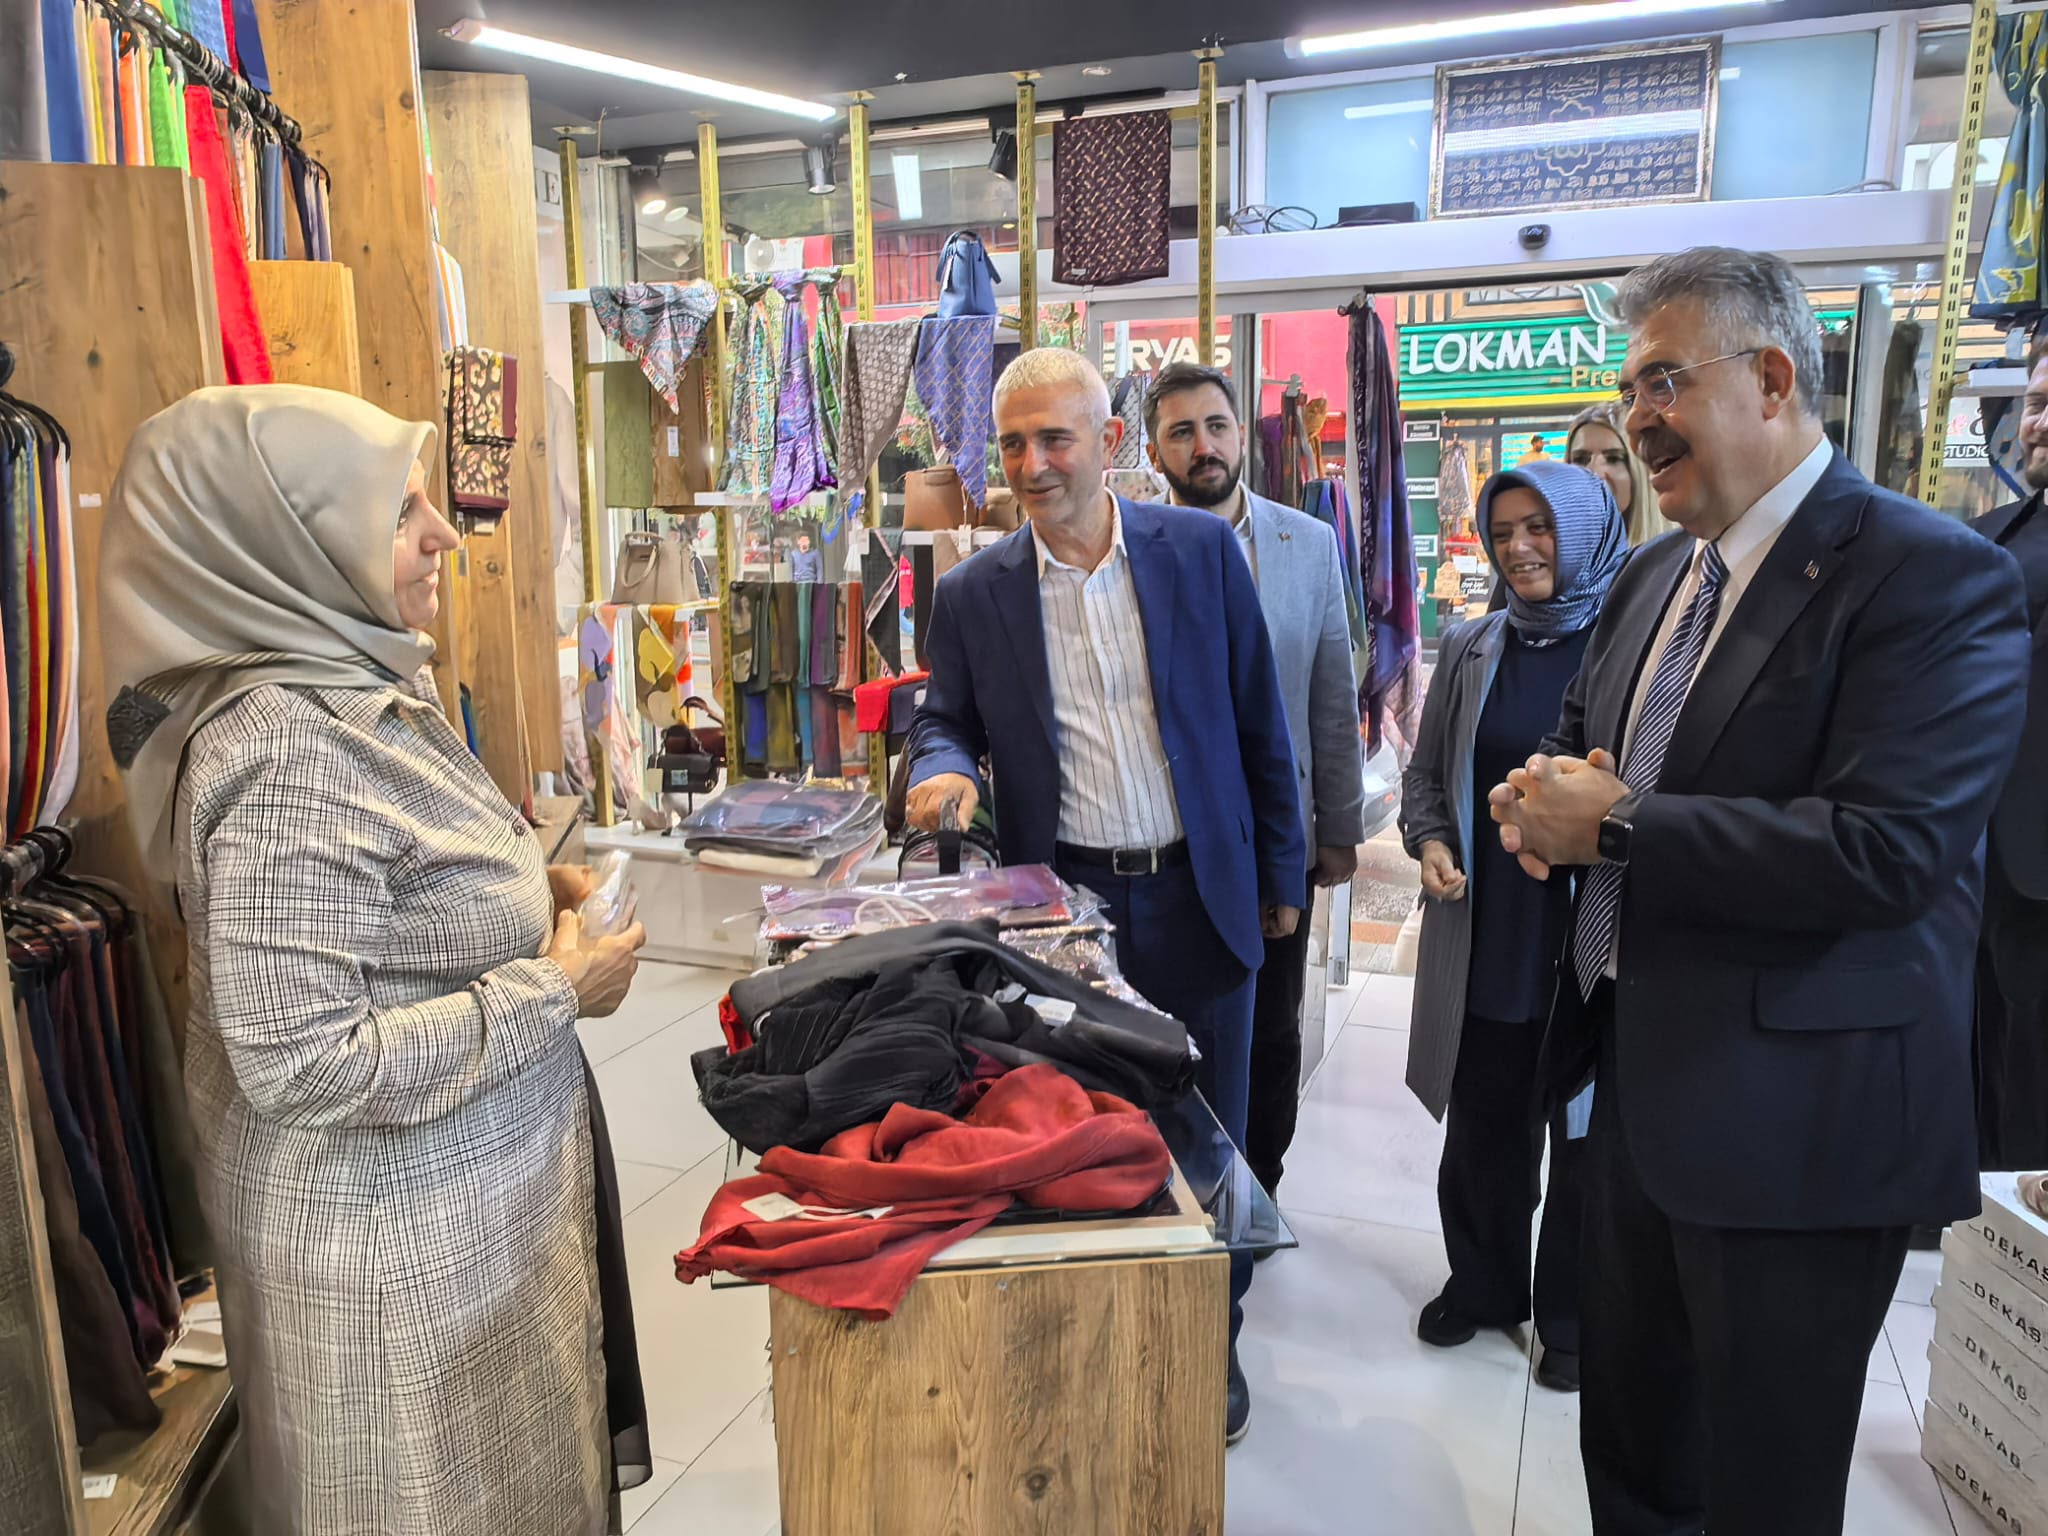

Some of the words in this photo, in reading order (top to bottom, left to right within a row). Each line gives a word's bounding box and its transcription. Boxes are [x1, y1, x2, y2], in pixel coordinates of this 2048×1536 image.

[1408, 323, 1606, 375] LOKMAN
[1571, 365, 1618, 389] Pre
[1974, 1282, 2042, 1344] DEKAS
[1965, 1336, 2028, 1401] DEKAS
